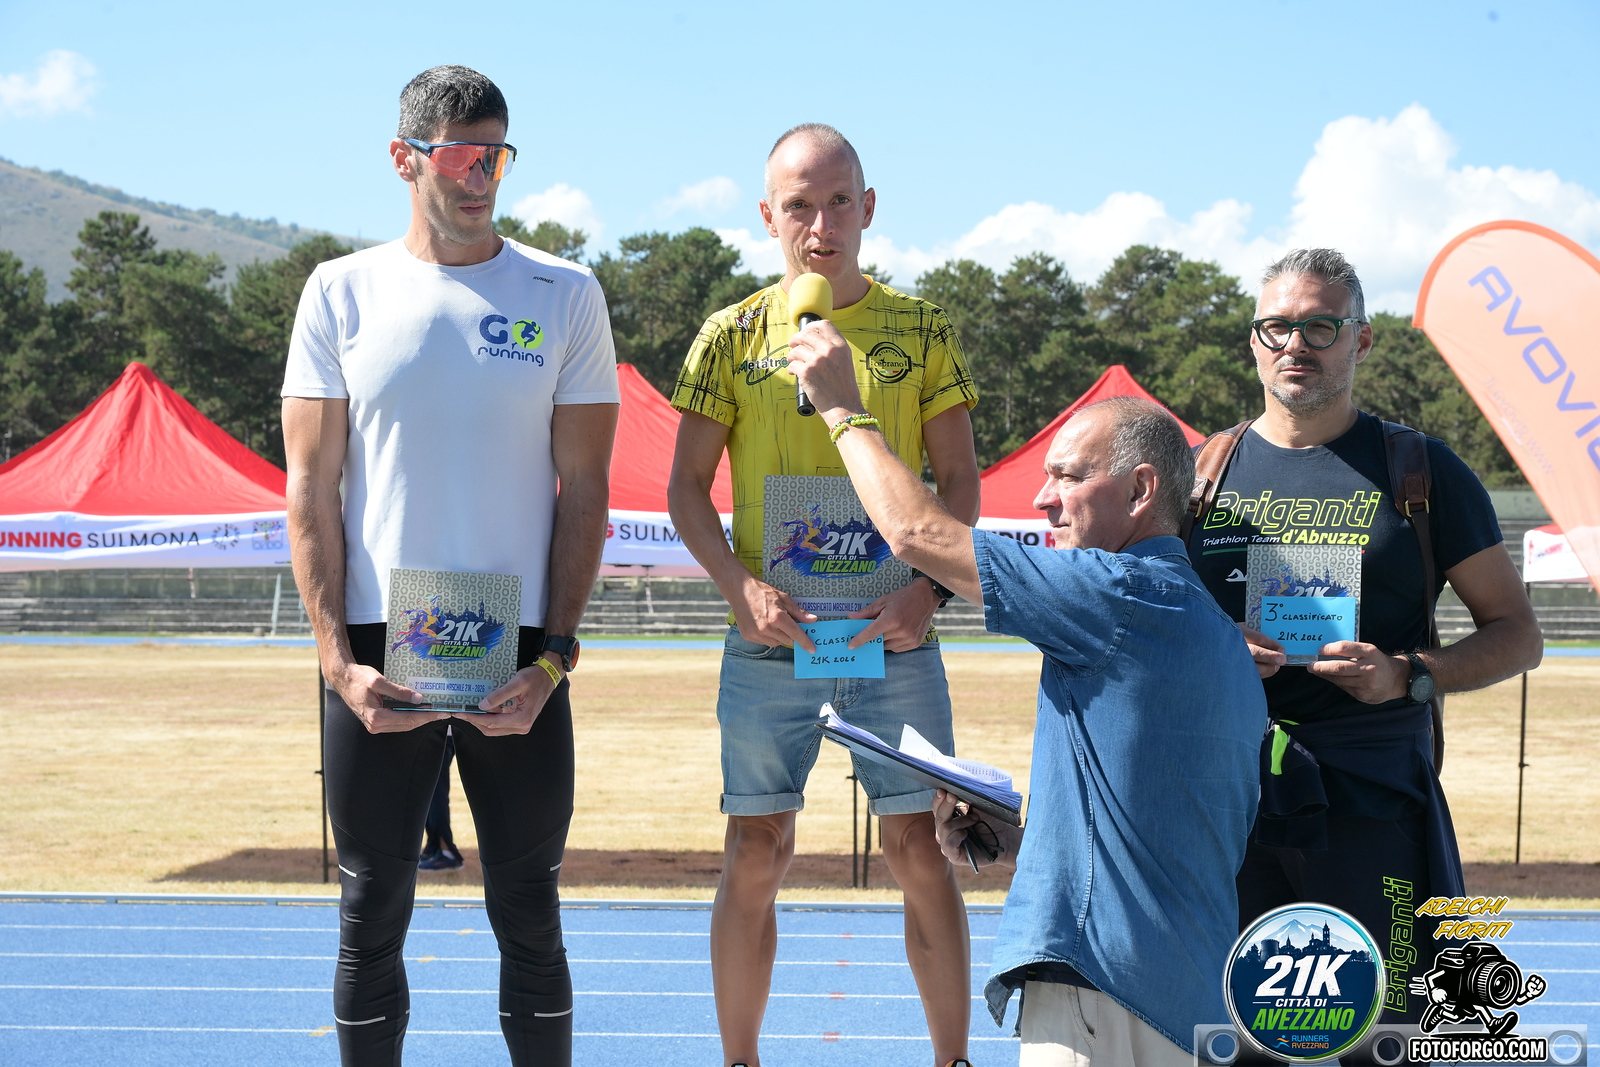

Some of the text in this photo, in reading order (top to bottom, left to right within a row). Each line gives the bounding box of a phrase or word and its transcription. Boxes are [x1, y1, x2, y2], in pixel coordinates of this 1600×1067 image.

[478, 346, 544, 367] running
[1203, 490, 1383, 535] Briganti
[87, 531, 201, 548] SULMONA
[819, 532, 872, 556] 21K
[1202, 529, 1370, 547] Triathlon Team d'Abruzzo
[811, 560, 877, 574] AVEZZANO
[435, 620, 485, 642] 21K
[1278, 631, 1323, 641] 21K 2026
[428, 645, 488, 658] AVEZZANO
[811, 655, 856, 665] 21K 2026
[1383, 876, 1418, 1013] Briganti
